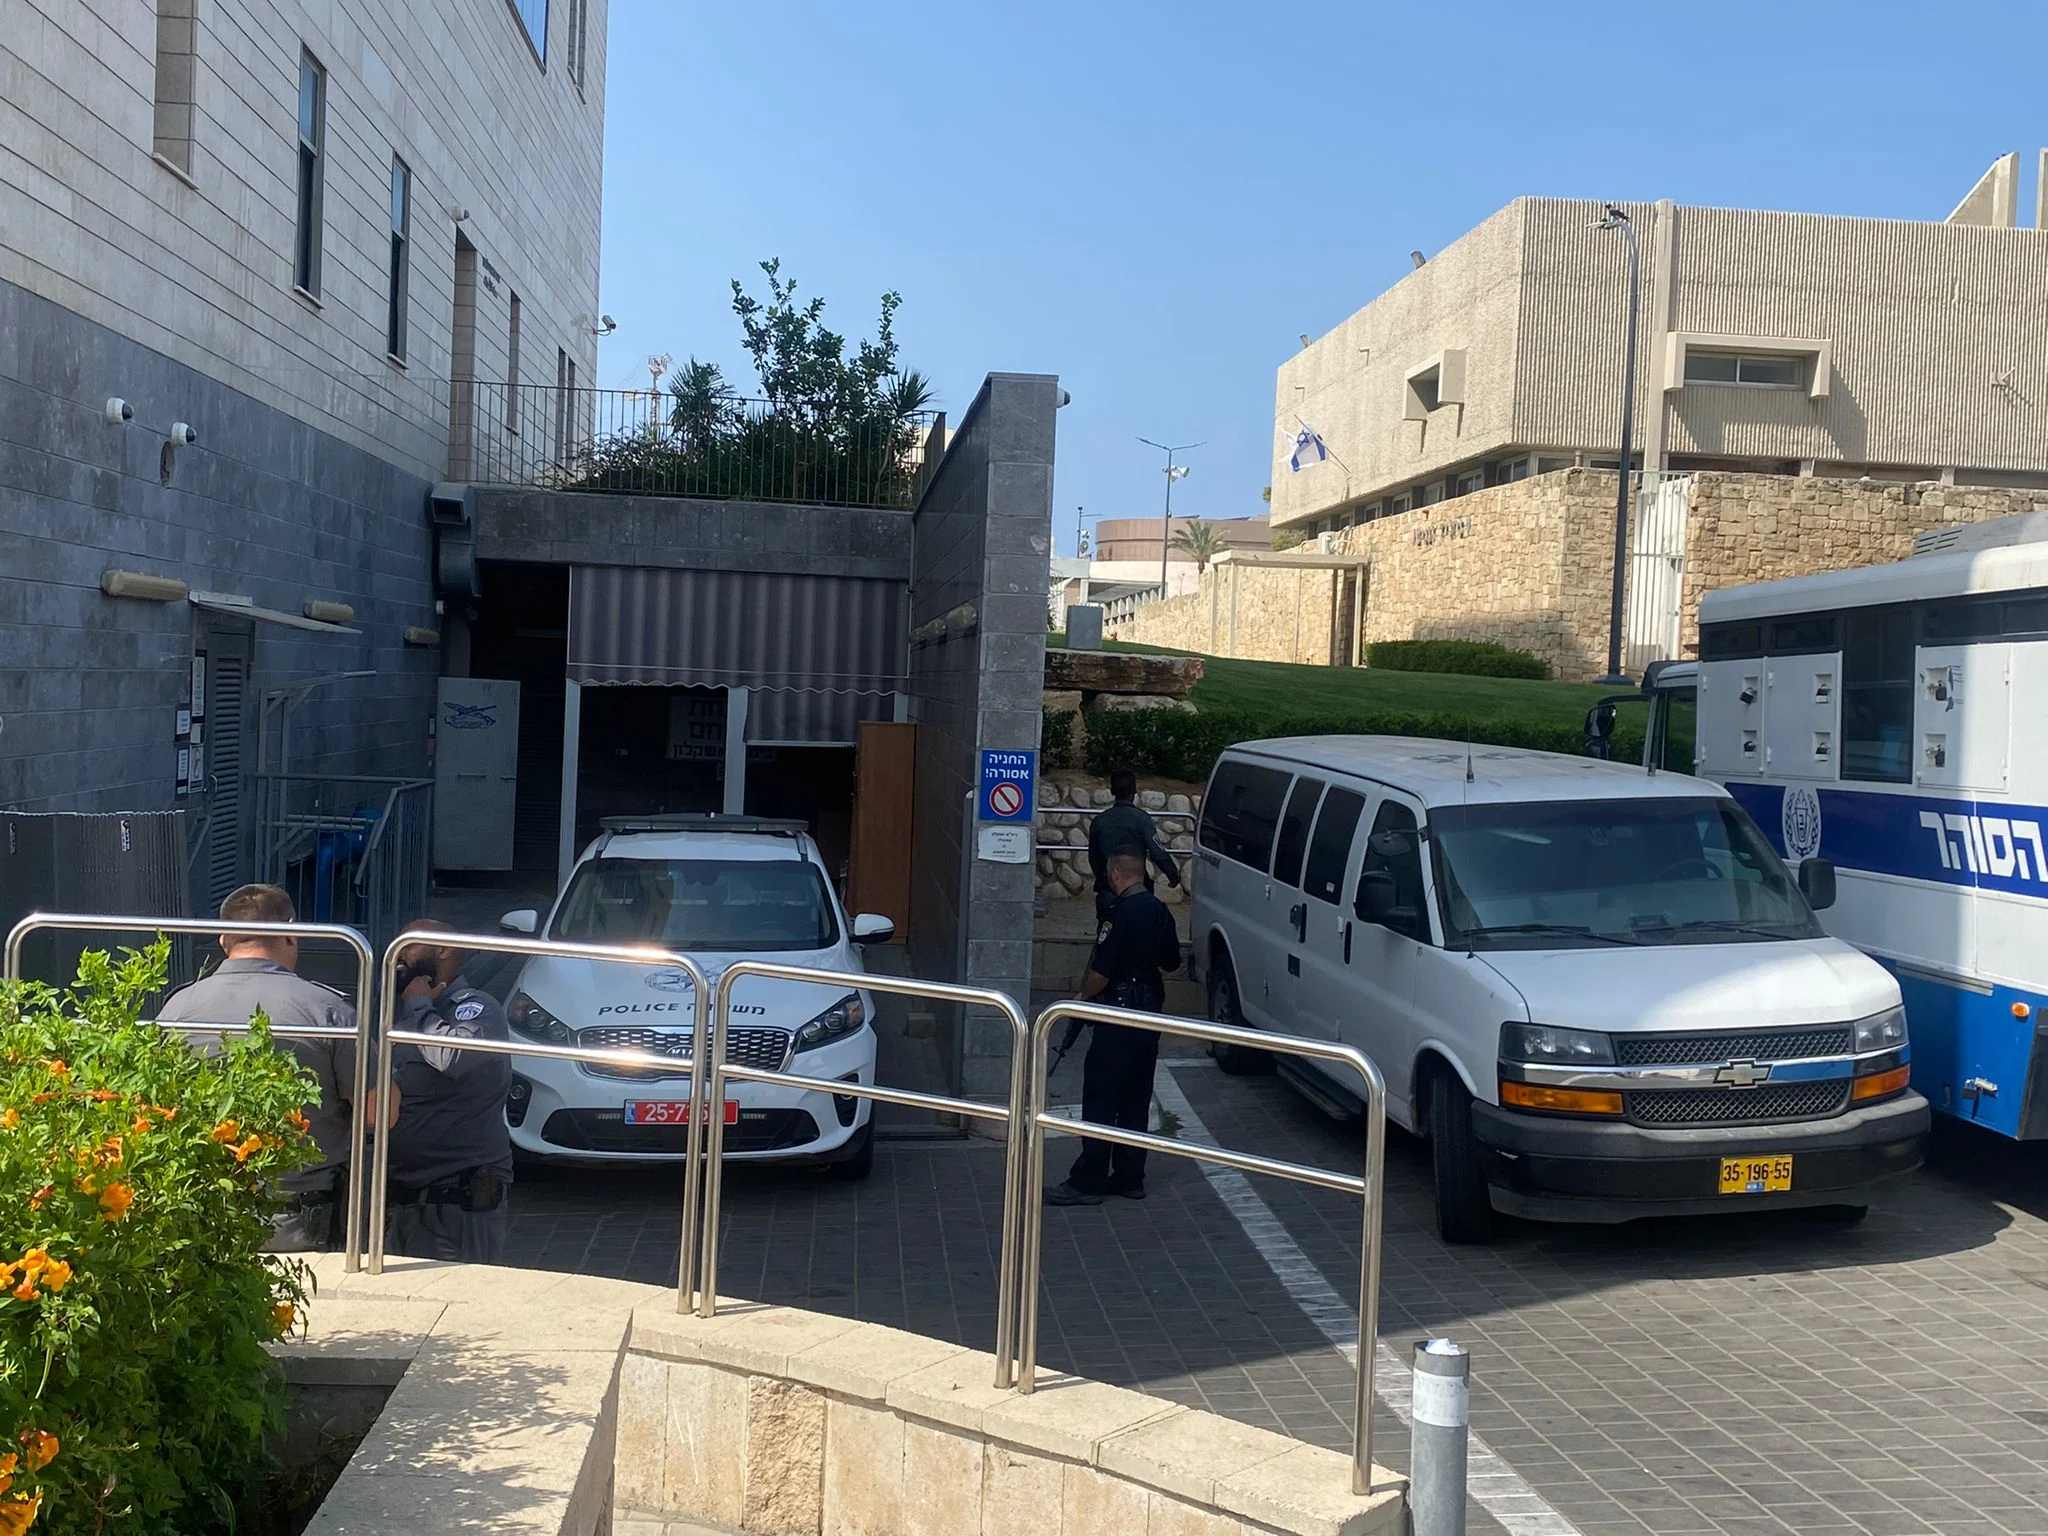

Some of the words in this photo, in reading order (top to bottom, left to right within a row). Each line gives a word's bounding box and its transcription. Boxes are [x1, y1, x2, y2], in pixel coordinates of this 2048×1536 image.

[989, 754, 1027, 765] החניה
[985, 768, 1029, 780] אסורה!
[1919, 811, 2048, 883] הסוהר
[598, 1002, 680, 1016] POLICE
[1723, 1161, 1791, 1182] 35-196-55
